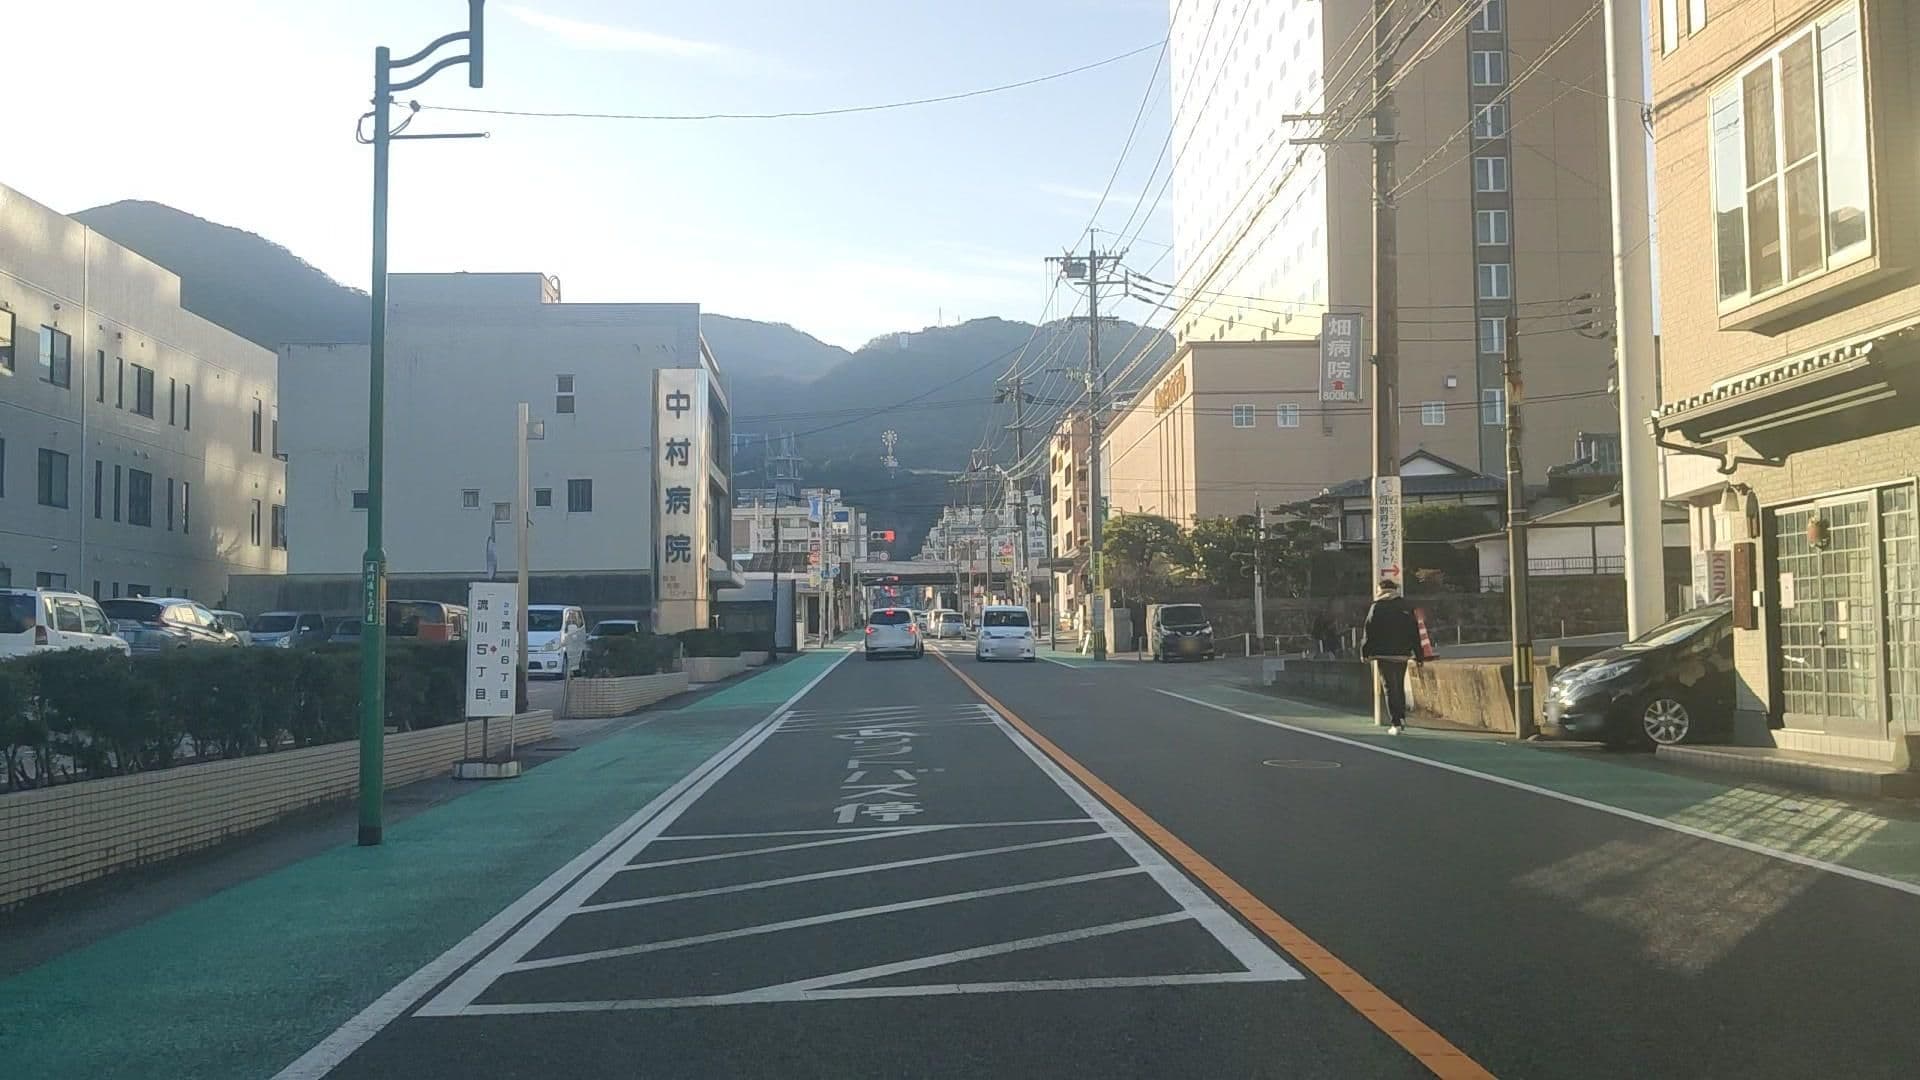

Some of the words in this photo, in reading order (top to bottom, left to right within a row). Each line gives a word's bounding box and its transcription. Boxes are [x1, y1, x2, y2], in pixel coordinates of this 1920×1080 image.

[1327, 317, 1351, 378] 畑病院
[665, 389, 691, 563] 中村病院
